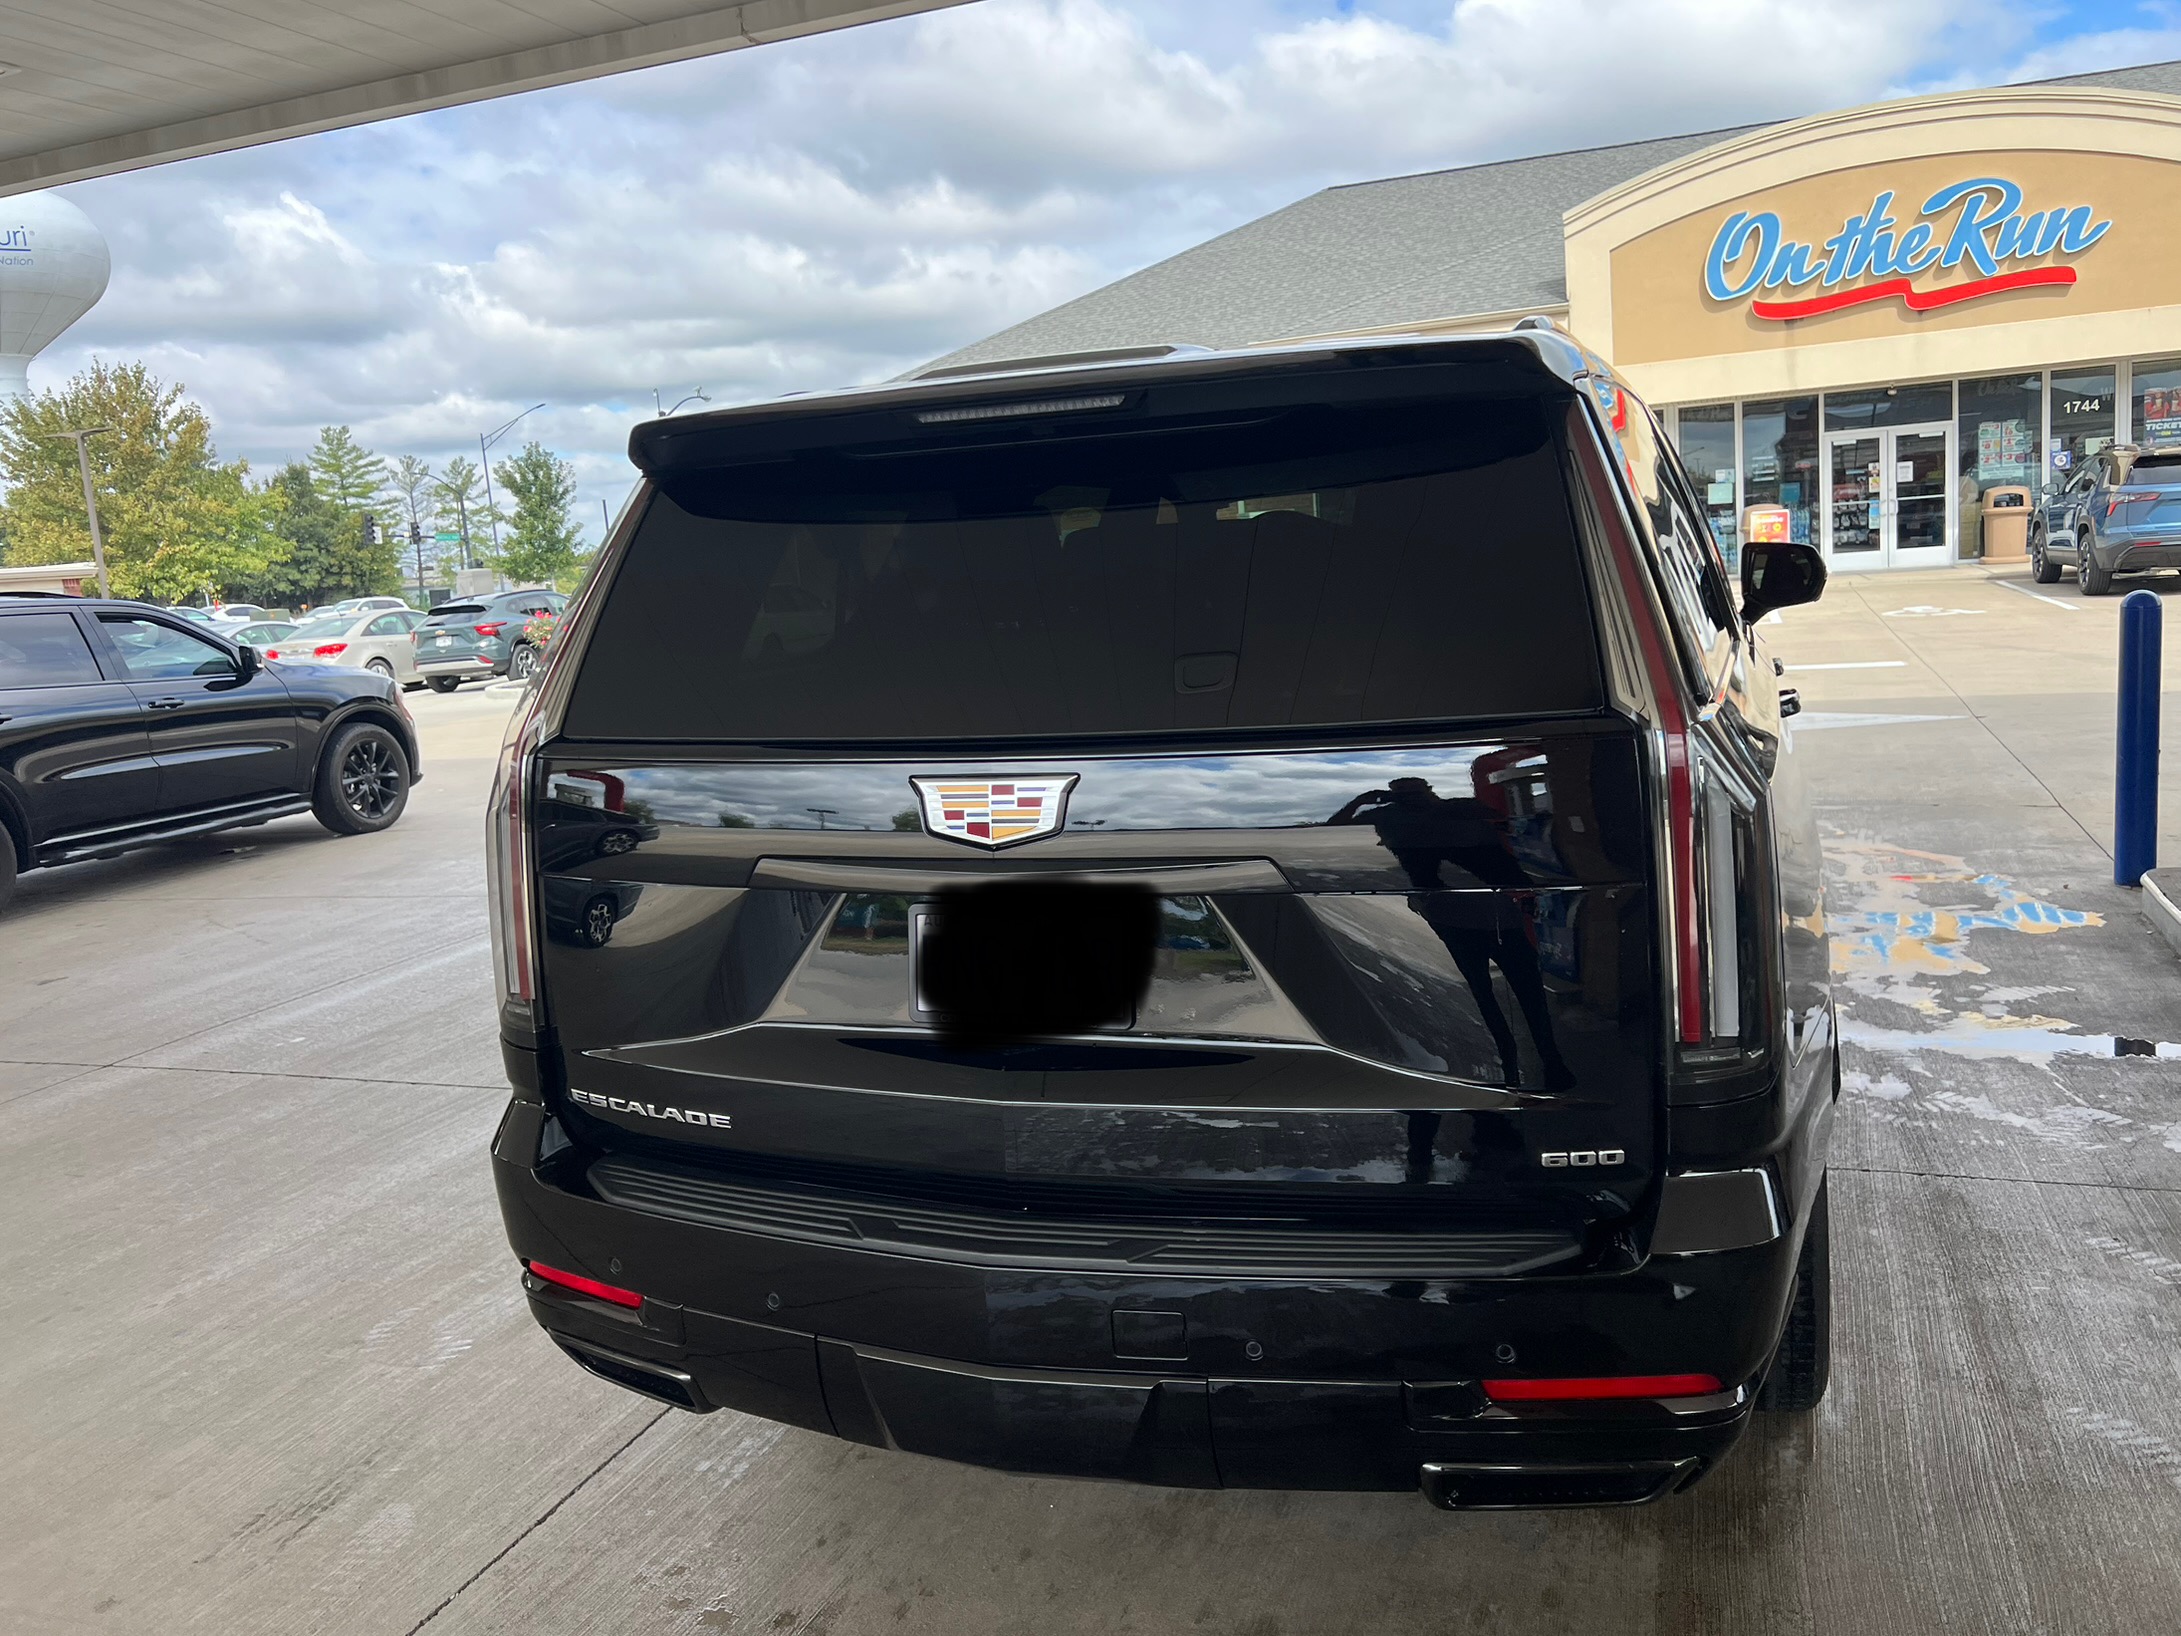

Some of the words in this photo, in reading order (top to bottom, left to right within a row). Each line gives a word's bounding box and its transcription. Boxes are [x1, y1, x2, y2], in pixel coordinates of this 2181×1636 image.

[1704, 211, 1825, 301] On
[1822, 190, 1942, 287] the
[1922, 177, 2112, 277] Run
[2063, 398, 2100, 414] 1744
[570, 1088, 732, 1129] ESCALADE
[1541, 1149, 1625, 1168] 600
